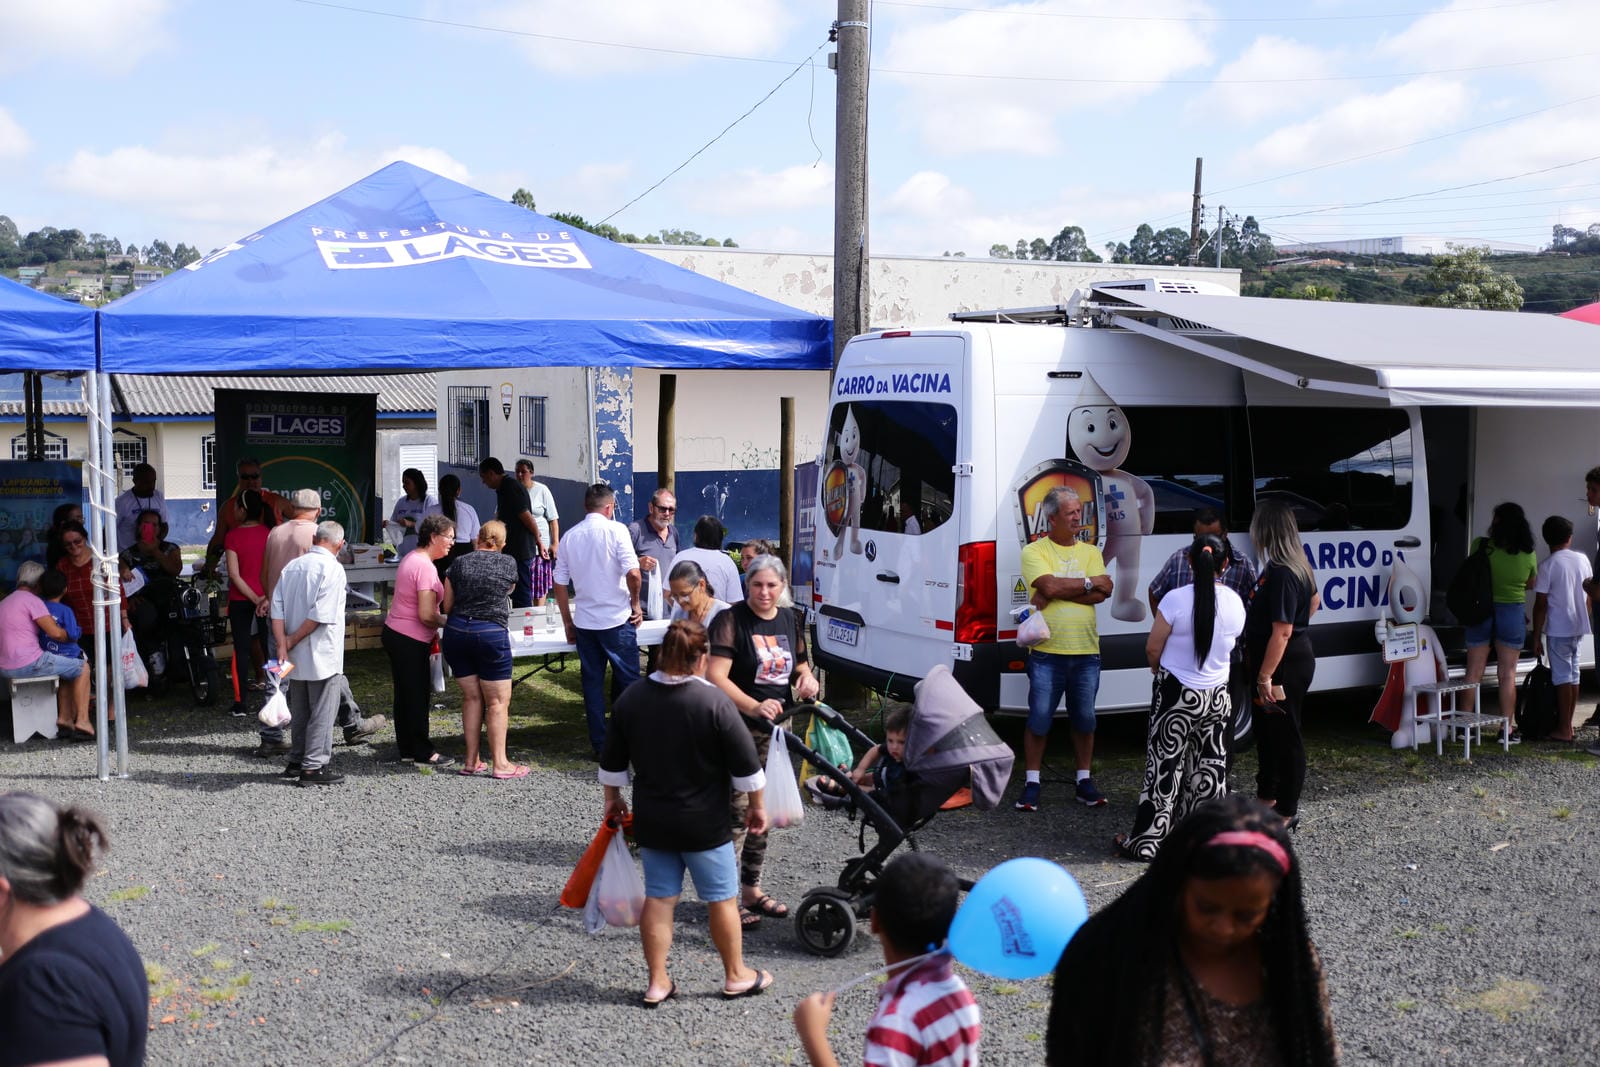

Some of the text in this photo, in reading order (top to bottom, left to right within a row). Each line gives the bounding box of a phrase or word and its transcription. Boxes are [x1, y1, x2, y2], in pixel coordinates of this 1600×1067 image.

[311, 222, 571, 241] PREFEITURA DE
[403, 235, 578, 264] LAGES
[837, 373, 952, 396] CARRO DA VACINA
[277, 418, 342, 433] LAGES
[1108, 510, 1126, 521] SUS
